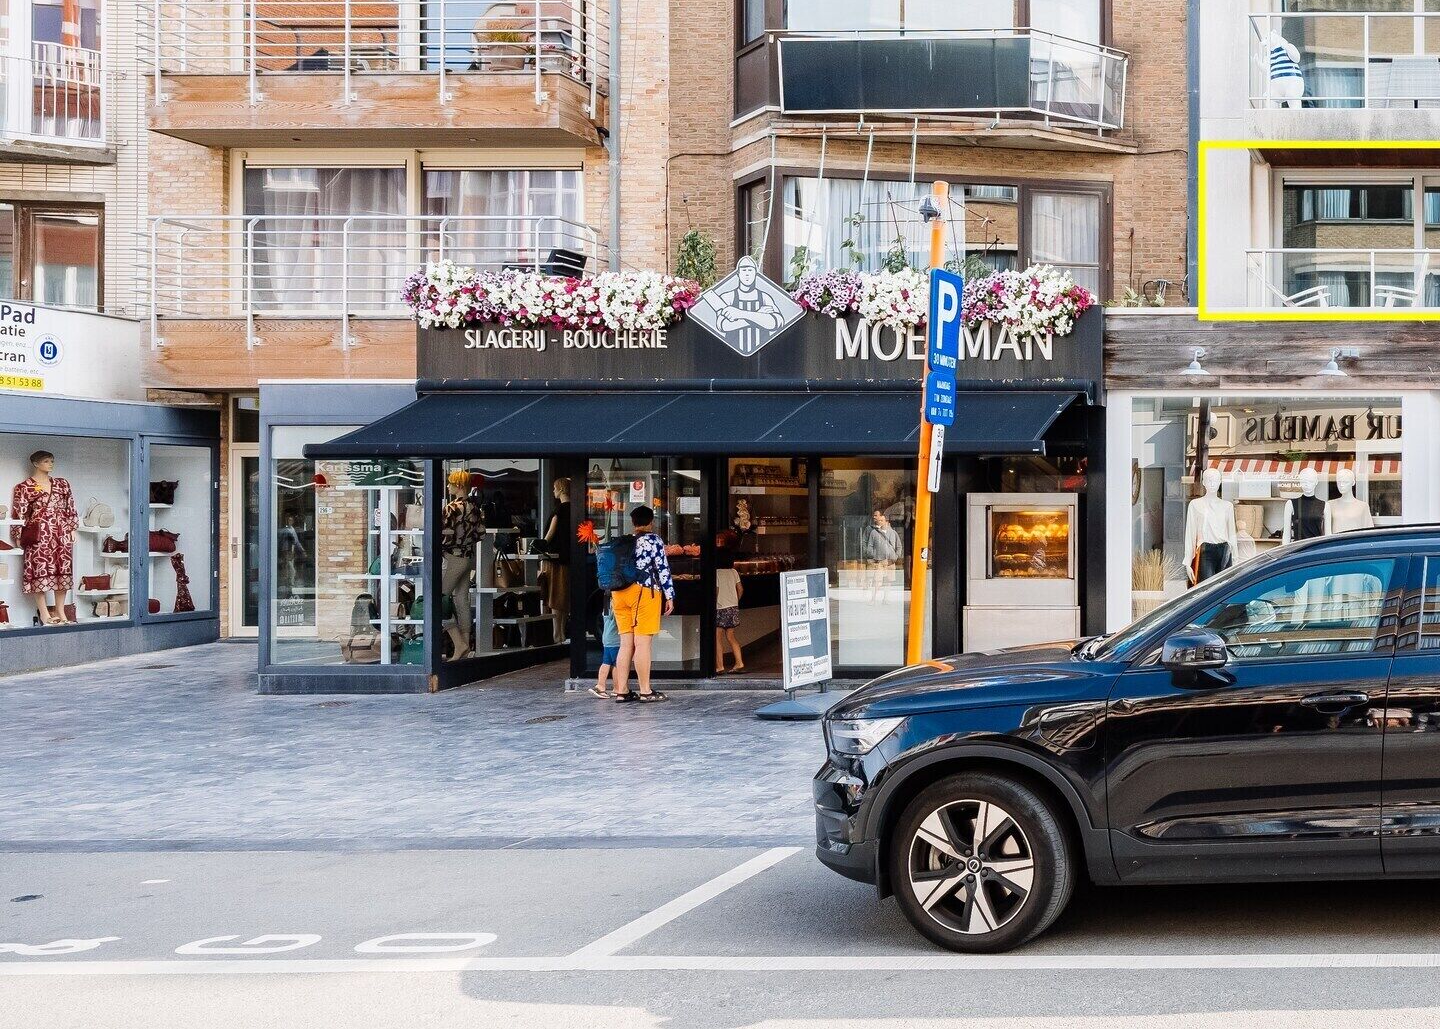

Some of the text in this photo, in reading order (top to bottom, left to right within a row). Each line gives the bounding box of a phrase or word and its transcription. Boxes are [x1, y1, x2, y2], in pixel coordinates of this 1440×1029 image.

[936, 279, 959, 350] P
[464, 329, 547, 352] SLAGERIJ
[563, 328, 668, 349] BOUCHERIE
[7, 376, 16, 386] 51
[20, 377, 30, 388] 53
[32, 378, 42, 388] 88
